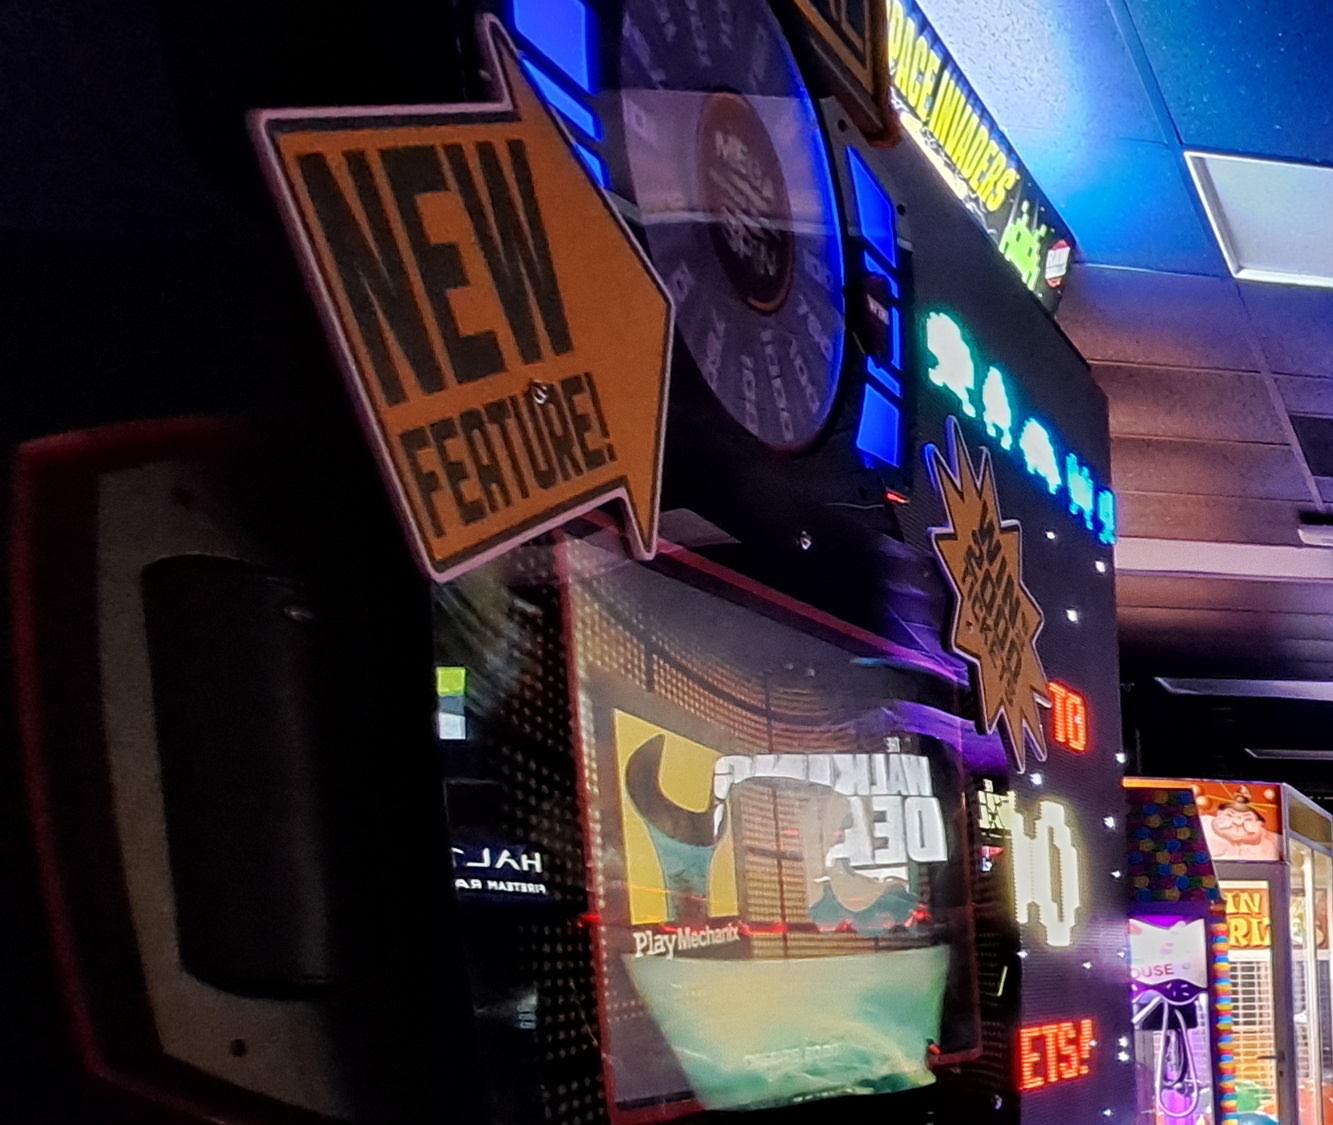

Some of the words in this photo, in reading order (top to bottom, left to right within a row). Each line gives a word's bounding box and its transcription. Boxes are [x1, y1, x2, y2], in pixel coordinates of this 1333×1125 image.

[928, 69, 1016, 212] INVADERS
[296, 137, 575, 408] NEW
[397, 371, 619, 540] FEATURE!
